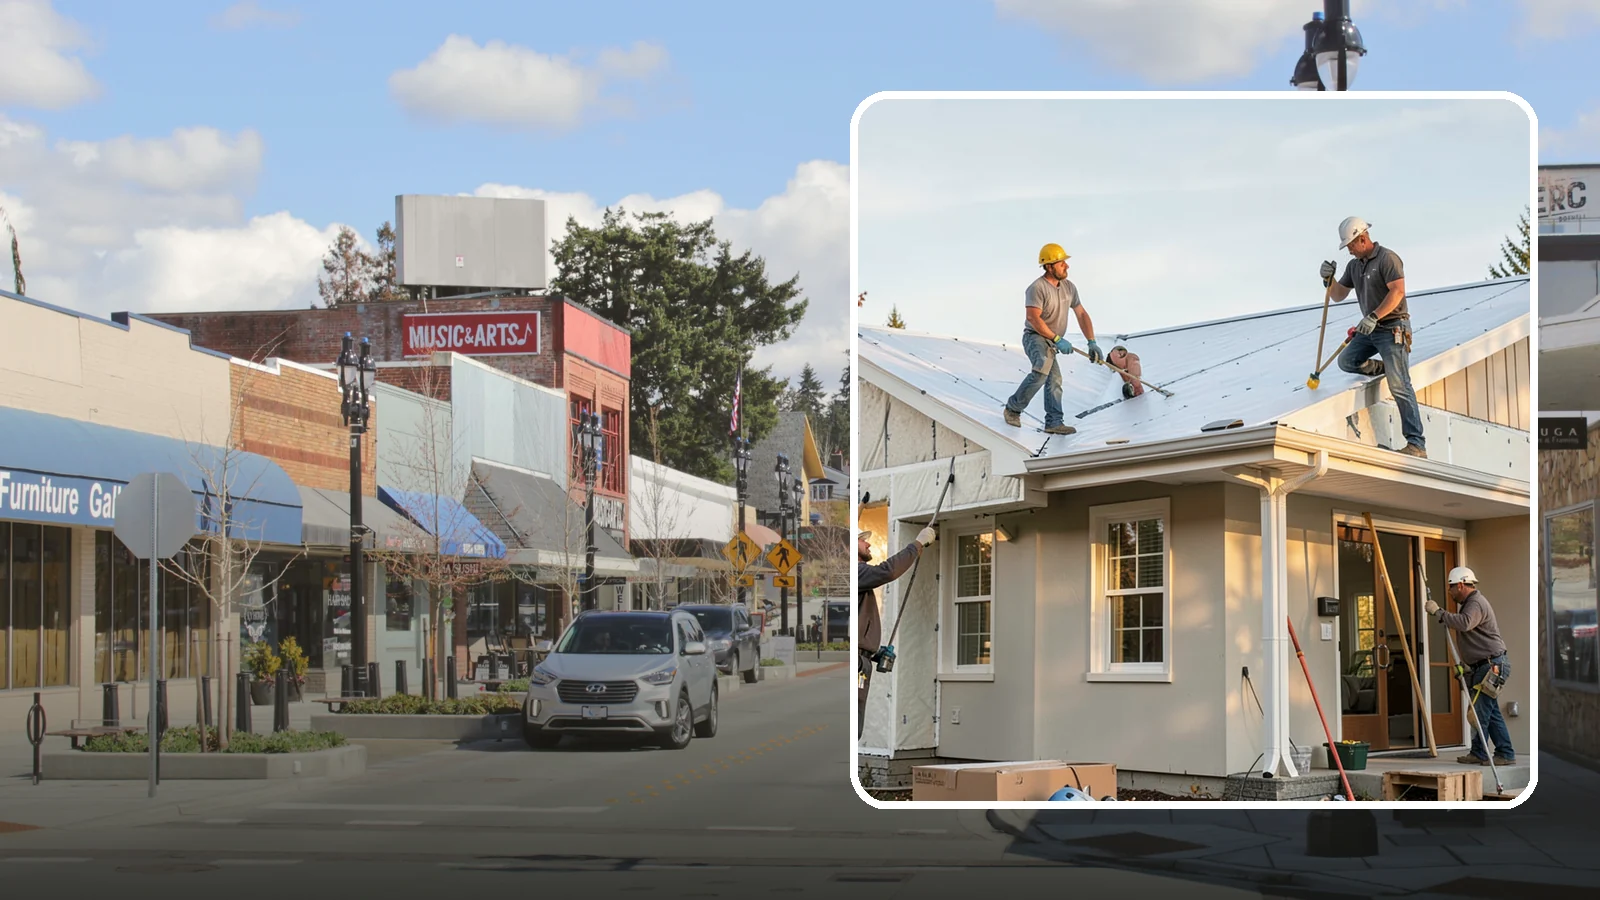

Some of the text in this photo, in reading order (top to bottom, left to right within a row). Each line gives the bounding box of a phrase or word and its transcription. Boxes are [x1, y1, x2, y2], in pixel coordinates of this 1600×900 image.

[408, 322, 520, 349] MUSIC&ARTS
[1540, 427, 1578, 437] UGA
[0, 471, 122, 519] Furniture Gal
[453, 563, 479, 574] SUSHI
